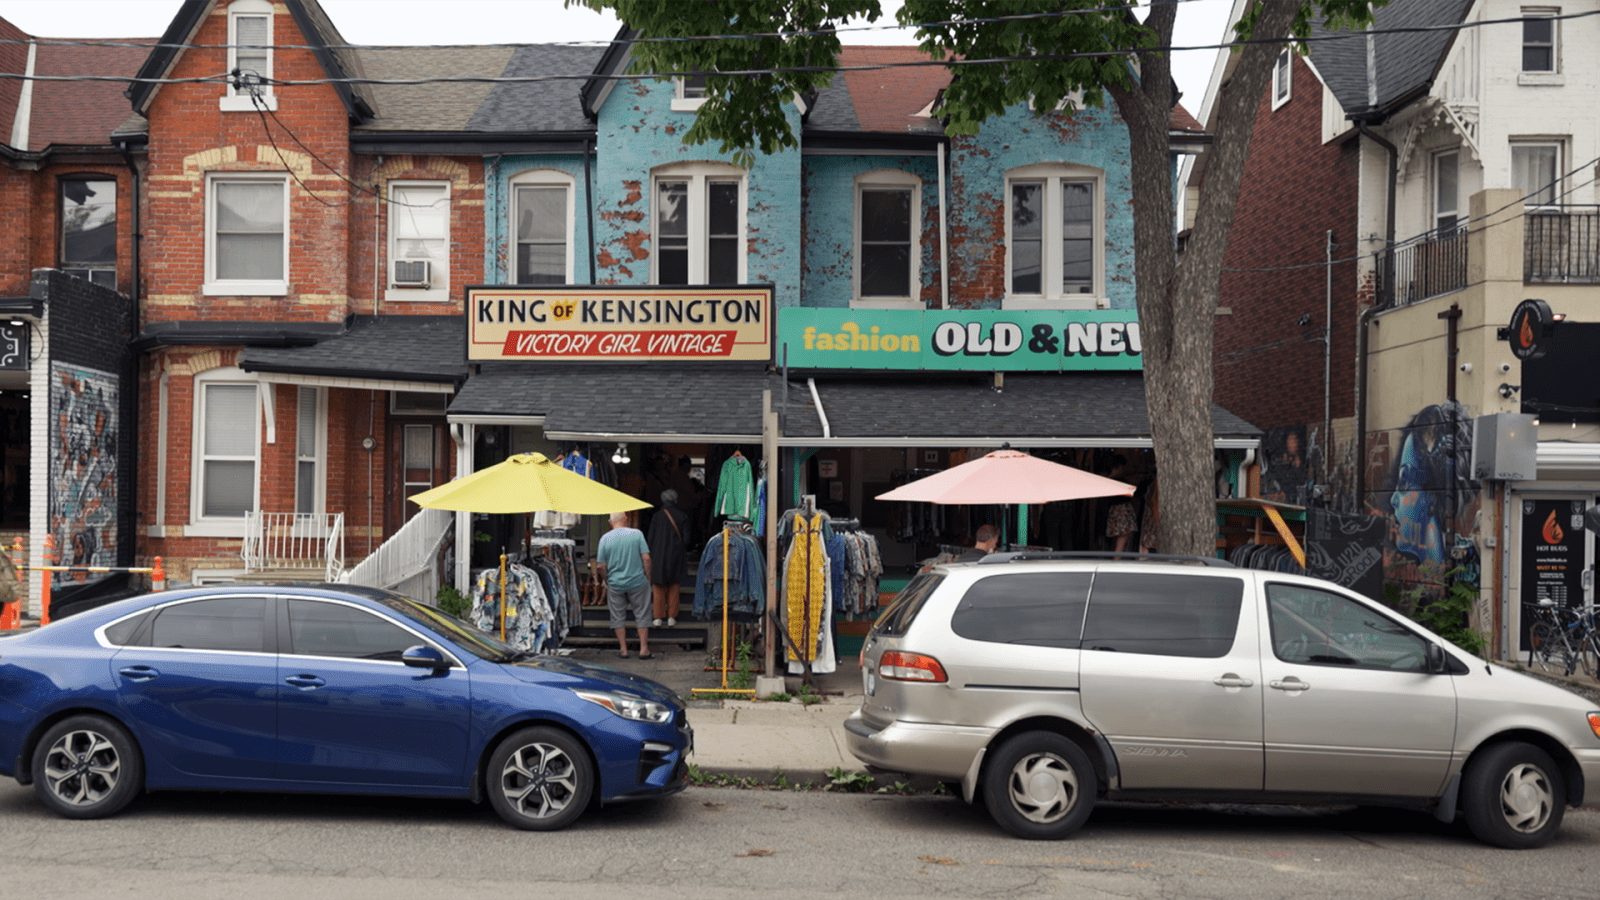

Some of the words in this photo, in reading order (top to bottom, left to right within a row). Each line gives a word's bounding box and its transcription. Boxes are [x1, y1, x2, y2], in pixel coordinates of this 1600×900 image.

[478, 299, 546, 323] KING
[553, 305, 574, 318] OF
[582, 299, 761, 323] KENSINGTON
[516, 333, 597, 354] VICTORY
[598, 333, 642, 354] GIRL
[647, 333, 728, 353] VINTAGE
[802, 321, 921, 352] fashion
[931, 321, 1023, 356] OLD
[1028, 323, 1059, 354] &
